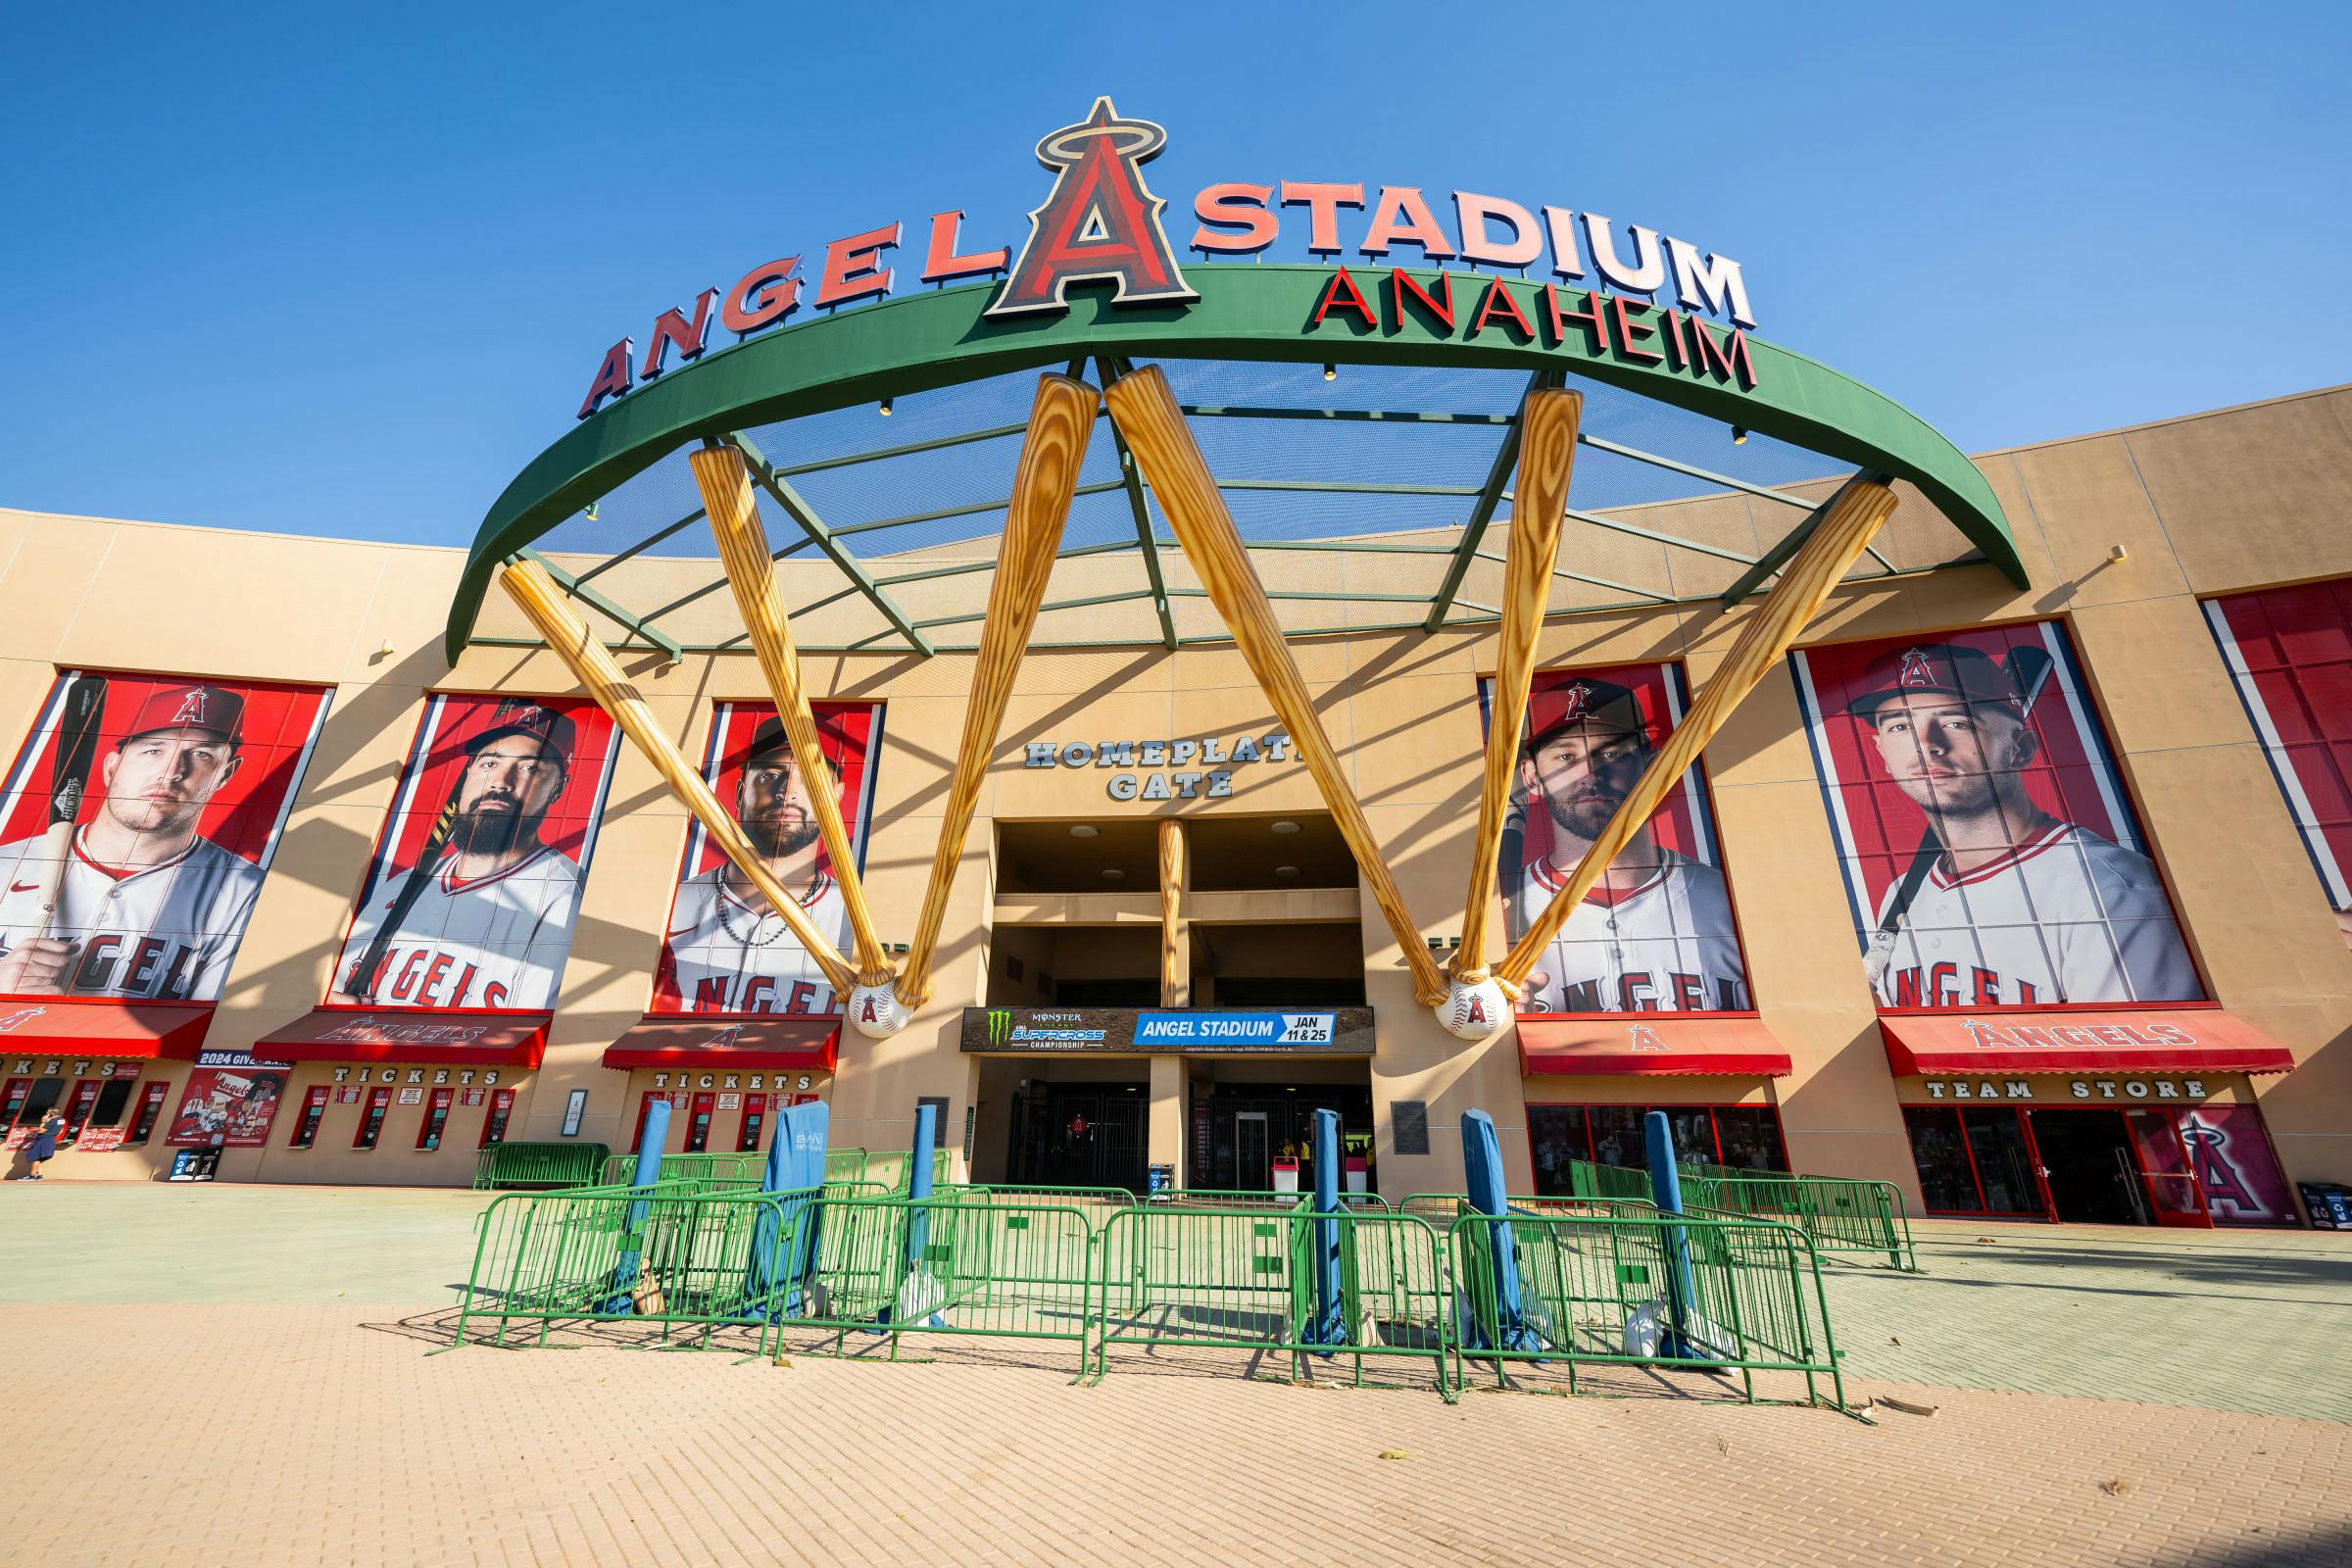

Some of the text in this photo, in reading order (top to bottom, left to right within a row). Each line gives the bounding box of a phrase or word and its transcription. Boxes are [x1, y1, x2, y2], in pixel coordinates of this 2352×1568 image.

[983, 95, 1200, 320] A
[576, 179, 1757, 419] ANGEL STADIUM
[1313, 266, 1757, 392] ANAHEIM
[1025, 736, 1305, 768] HOMEPLAT
[1107, 771, 1233, 801] GATE
[1143, 1021, 1273, 1037] ANGEL STADIUM
[1294, 1017, 1318, 1028] JAN
[1010, 1029, 1106, 1041] SUPERCROSS
[1287, 1030, 1326, 1041] 11 & 25
[1960, 1018, 2197, 1049] ANGELS
[200, 1053, 232, 1064] 2024
[0, 1059, 117, 1077] KETS
[334, 1067, 499, 1085] TICKETS
[655, 1073, 811, 1091] TICKETS
[1926, 1080, 2208, 1099] TEAM STORE
